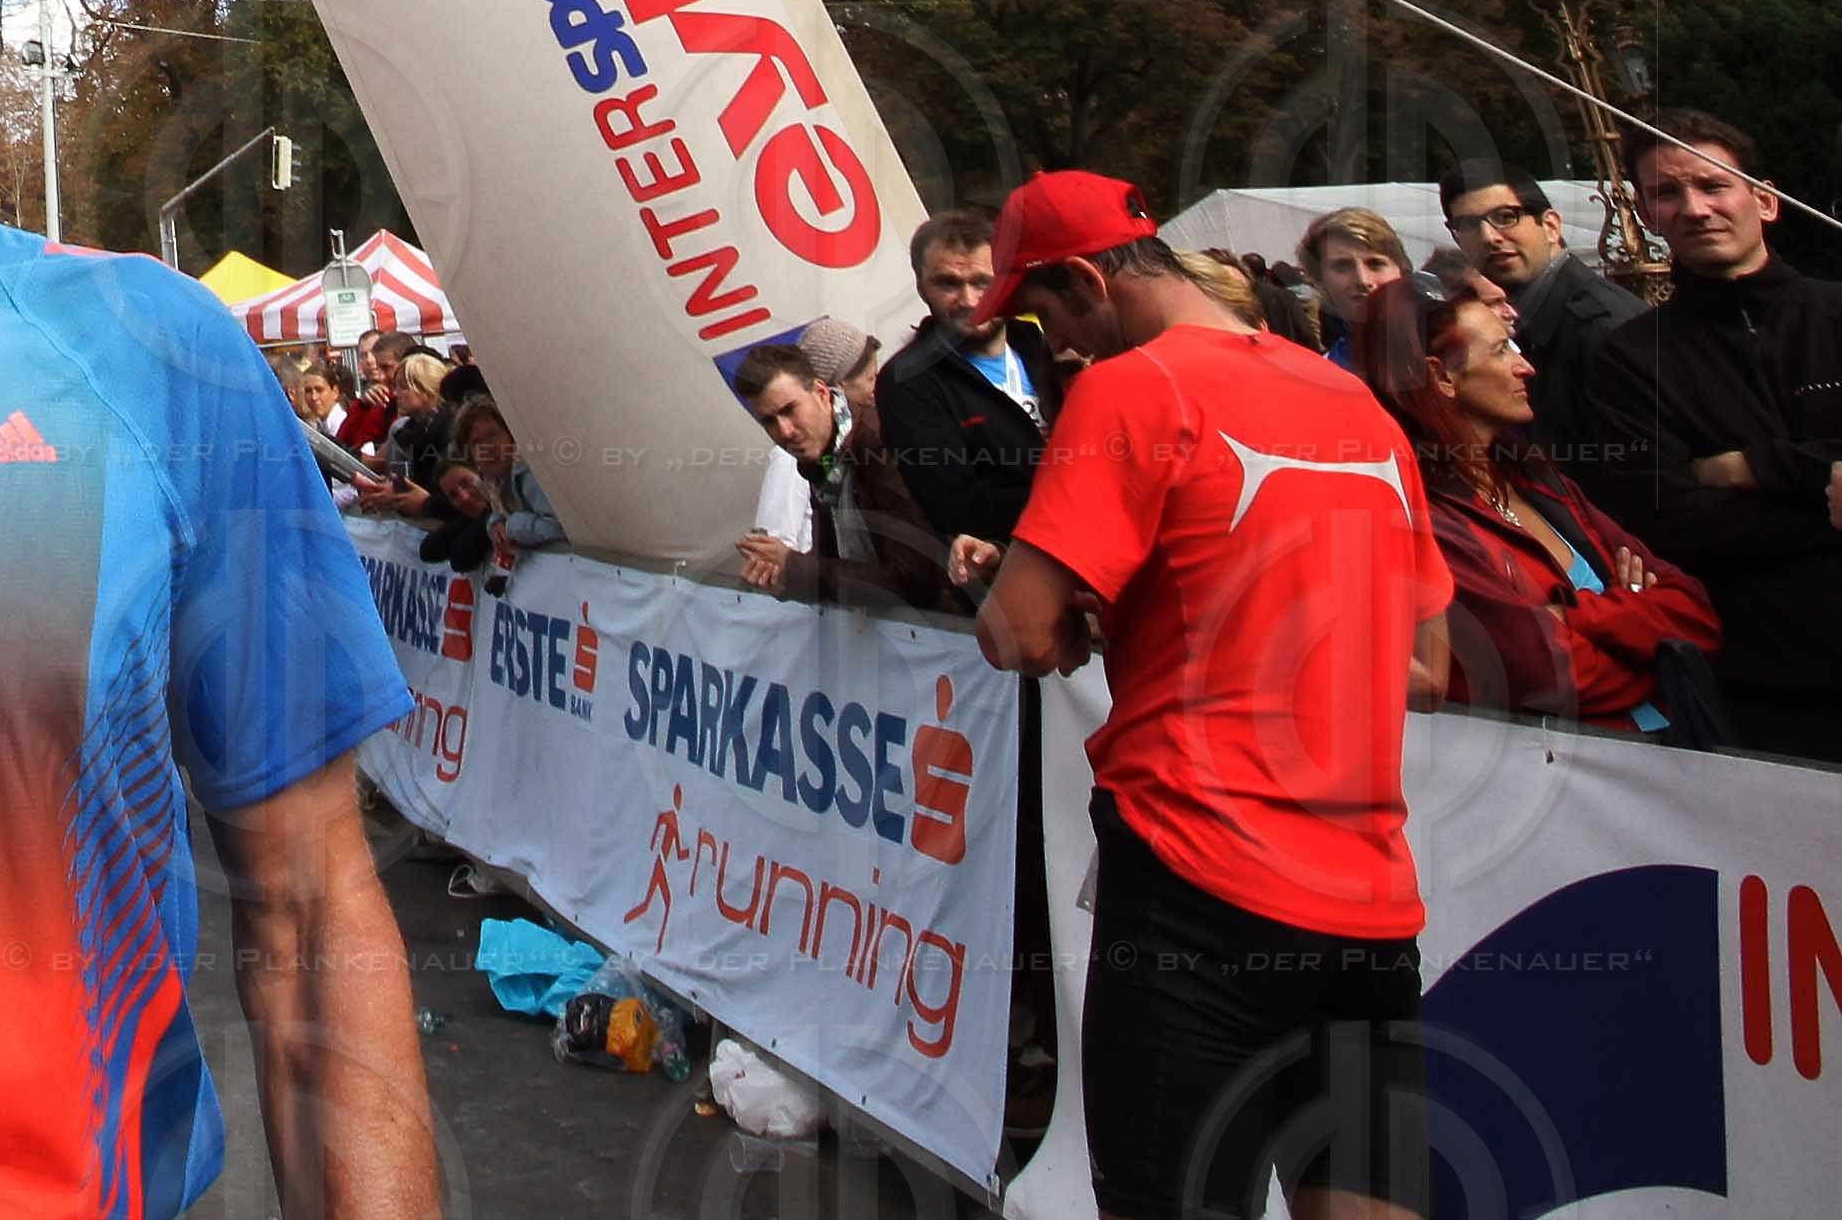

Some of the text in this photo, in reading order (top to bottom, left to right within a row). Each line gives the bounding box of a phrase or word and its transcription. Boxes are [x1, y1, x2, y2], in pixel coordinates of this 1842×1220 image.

[490, 601, 571, 711] ERSTE
[624, 640, 908, 844] SPARKASSE
[689, 826, 966, 1059] running
